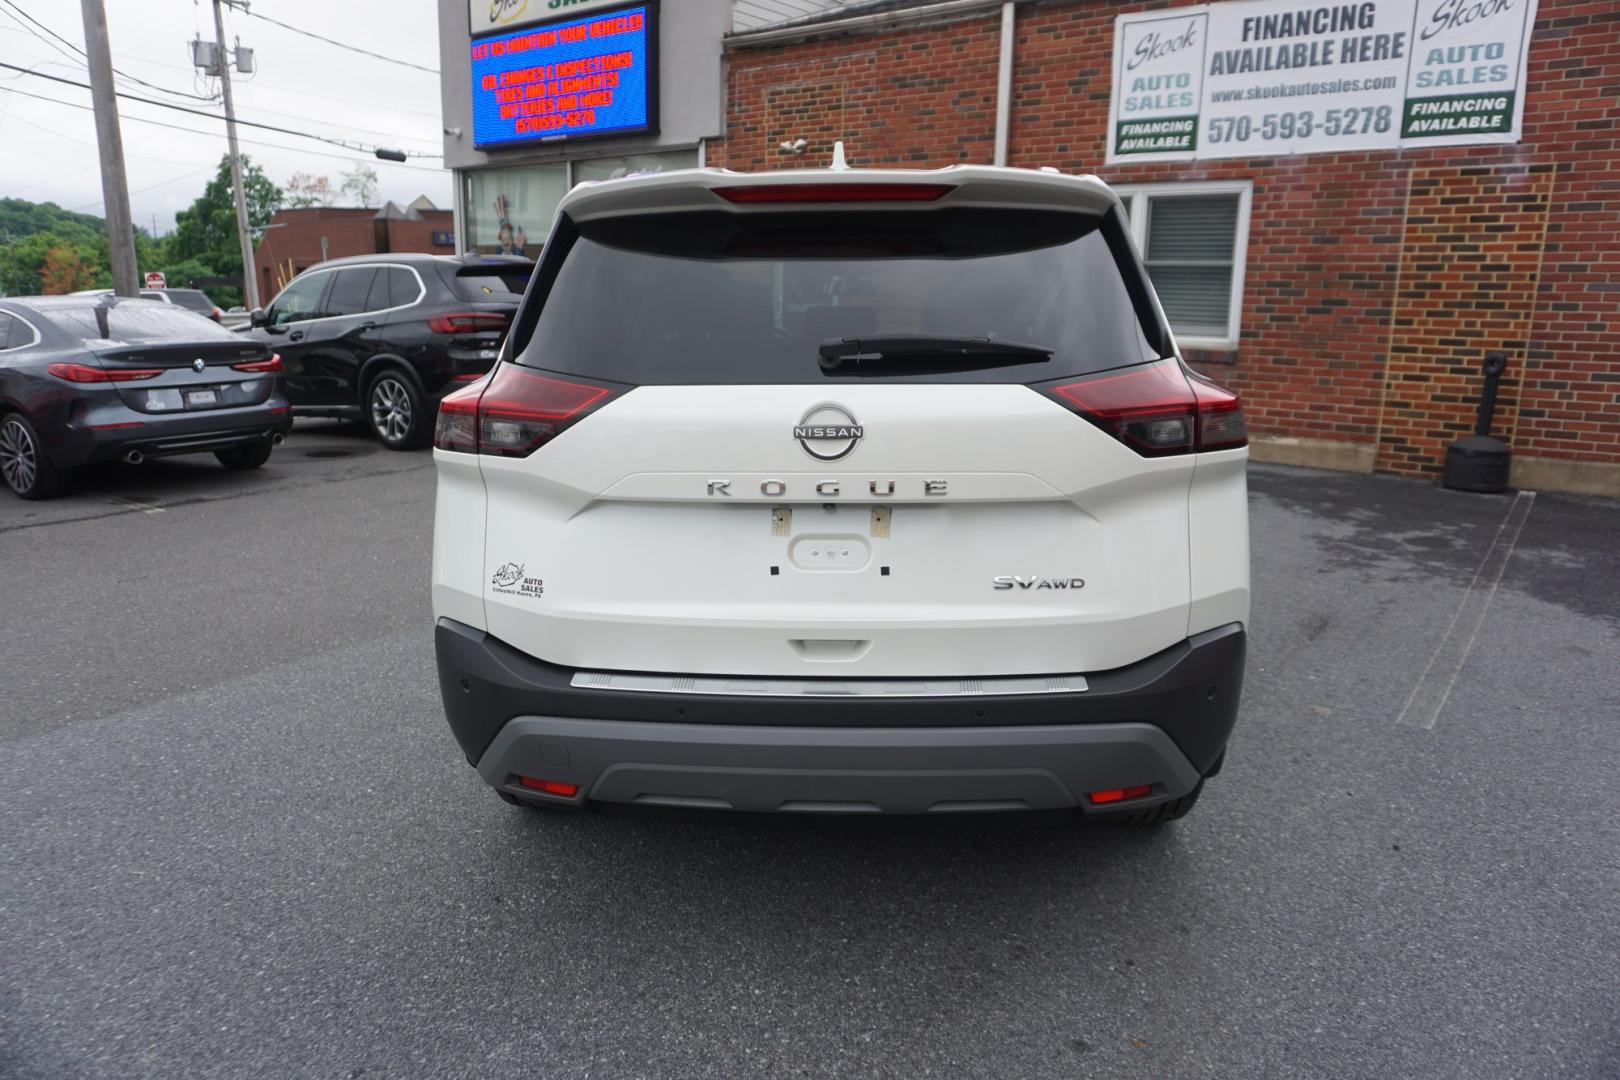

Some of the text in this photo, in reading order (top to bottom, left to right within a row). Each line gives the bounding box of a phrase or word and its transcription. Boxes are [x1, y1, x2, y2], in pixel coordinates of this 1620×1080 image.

[1242, 2, 1376, 42] FINANCING
[1127, 20, 1198, 70] Skook
[1210, 32, 1406, 76] AVAILABLE HERE
[1425, 42, 1504, 66] AUTO
[1131, 72, 1191, 93] AUTO
[1416, 64, 1508, 88] SALES
[1210, 76, 1397, 103] www.skookautosales.com
[1125, 92, 1193, 112] SALES
[1410, 97, 1507, 116] FINANCING
[1121, 120, 1194, 136] FINANCING
[1208, 104, 1393, 144] 570-593-5278
[1408, 115, 1503, 133] AVAILABLE
[1120, 136, 1191, 150] AVAILABLE
[794, 426, 863, 438] NISSAN
[706, 479, 948, 497] ROGUE
[521, 585, 543, 593] SALES
[523, 578, 543, 586] AUTO
[1037, 578, 1085, 590] AWD
